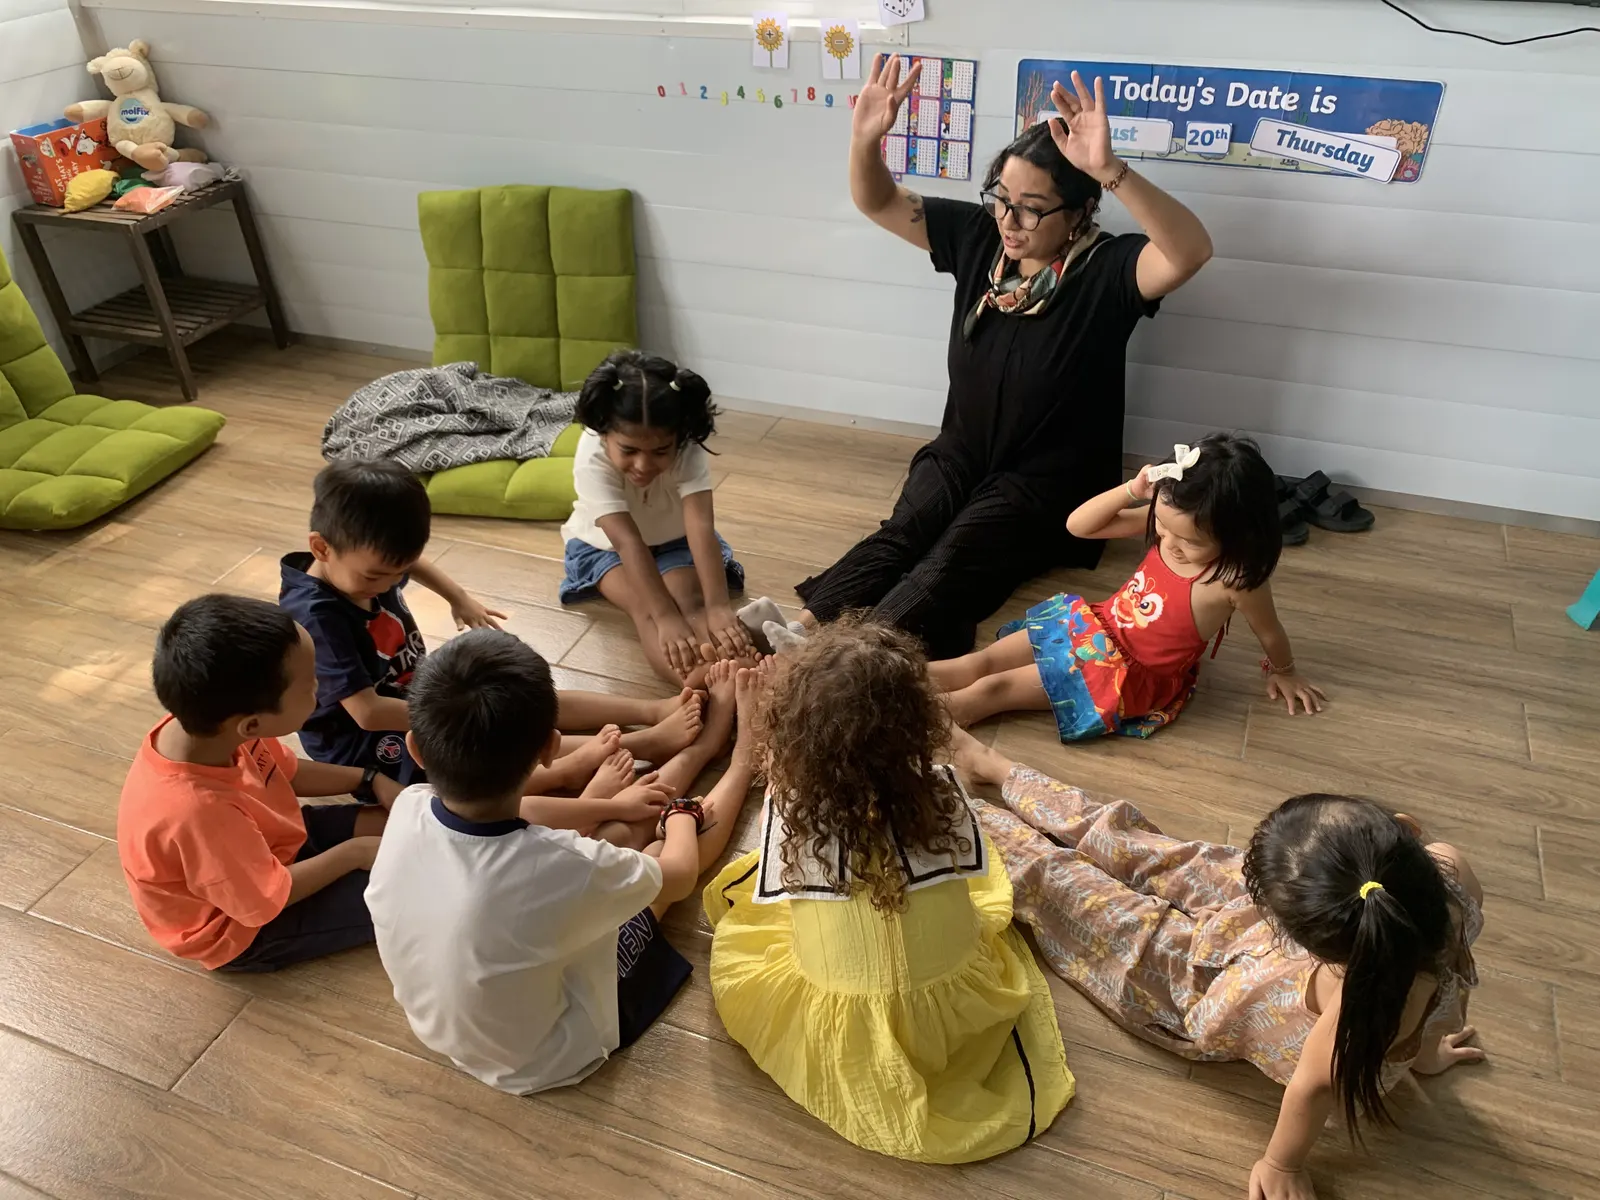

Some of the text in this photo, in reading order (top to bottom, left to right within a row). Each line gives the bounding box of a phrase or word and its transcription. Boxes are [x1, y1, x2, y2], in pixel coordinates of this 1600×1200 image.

[657, 85, 666, 98] 0
[679, 82, 688, 96] 1
[700, 85, 708, 100] 2
[737, 85, 746, 99] 4
[774, 95, 783, 109] 6
[789, 88, 798, 103] 7
[807, 86, 816, 101] 8
[825, 94, 834, 108] 9
[1109, 75, 1338, 114] Today's Date is
[1110, 126, 1138, 142] ust
[1187, 128, 1228, 147] 20th
[1277, 129, 1375, 173] Thursday
